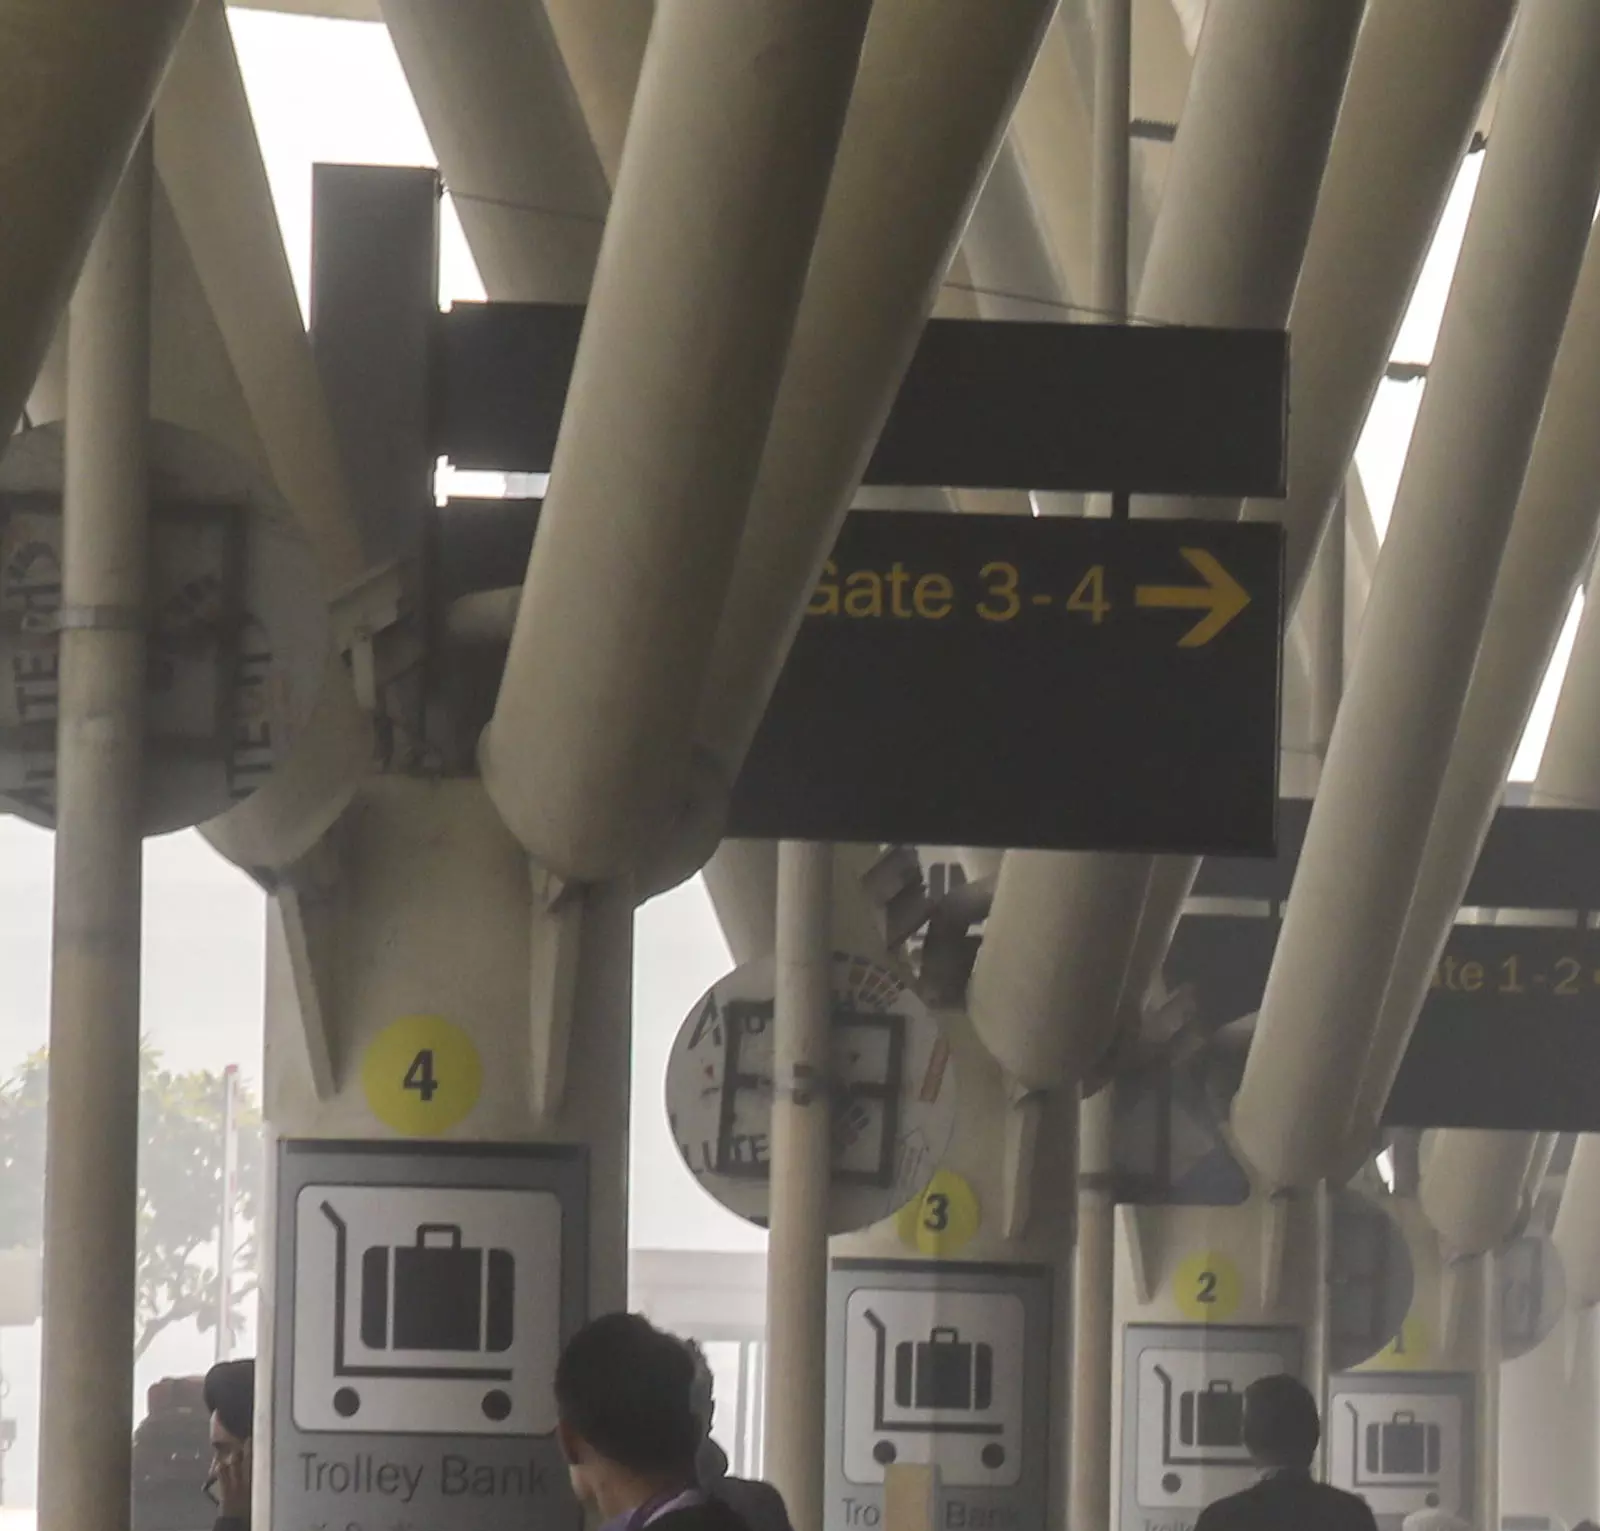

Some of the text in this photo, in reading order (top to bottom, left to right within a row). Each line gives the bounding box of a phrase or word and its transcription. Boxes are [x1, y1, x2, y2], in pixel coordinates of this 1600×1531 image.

[1431, 955, 1485, 992] te
[402, 1049, 438, 1101] 4
[924, 1194, 949, 1232] 3
[1196, 1271, 1217, 1303] 2
[299, 1451, 550, 1503] Trolley Bank
